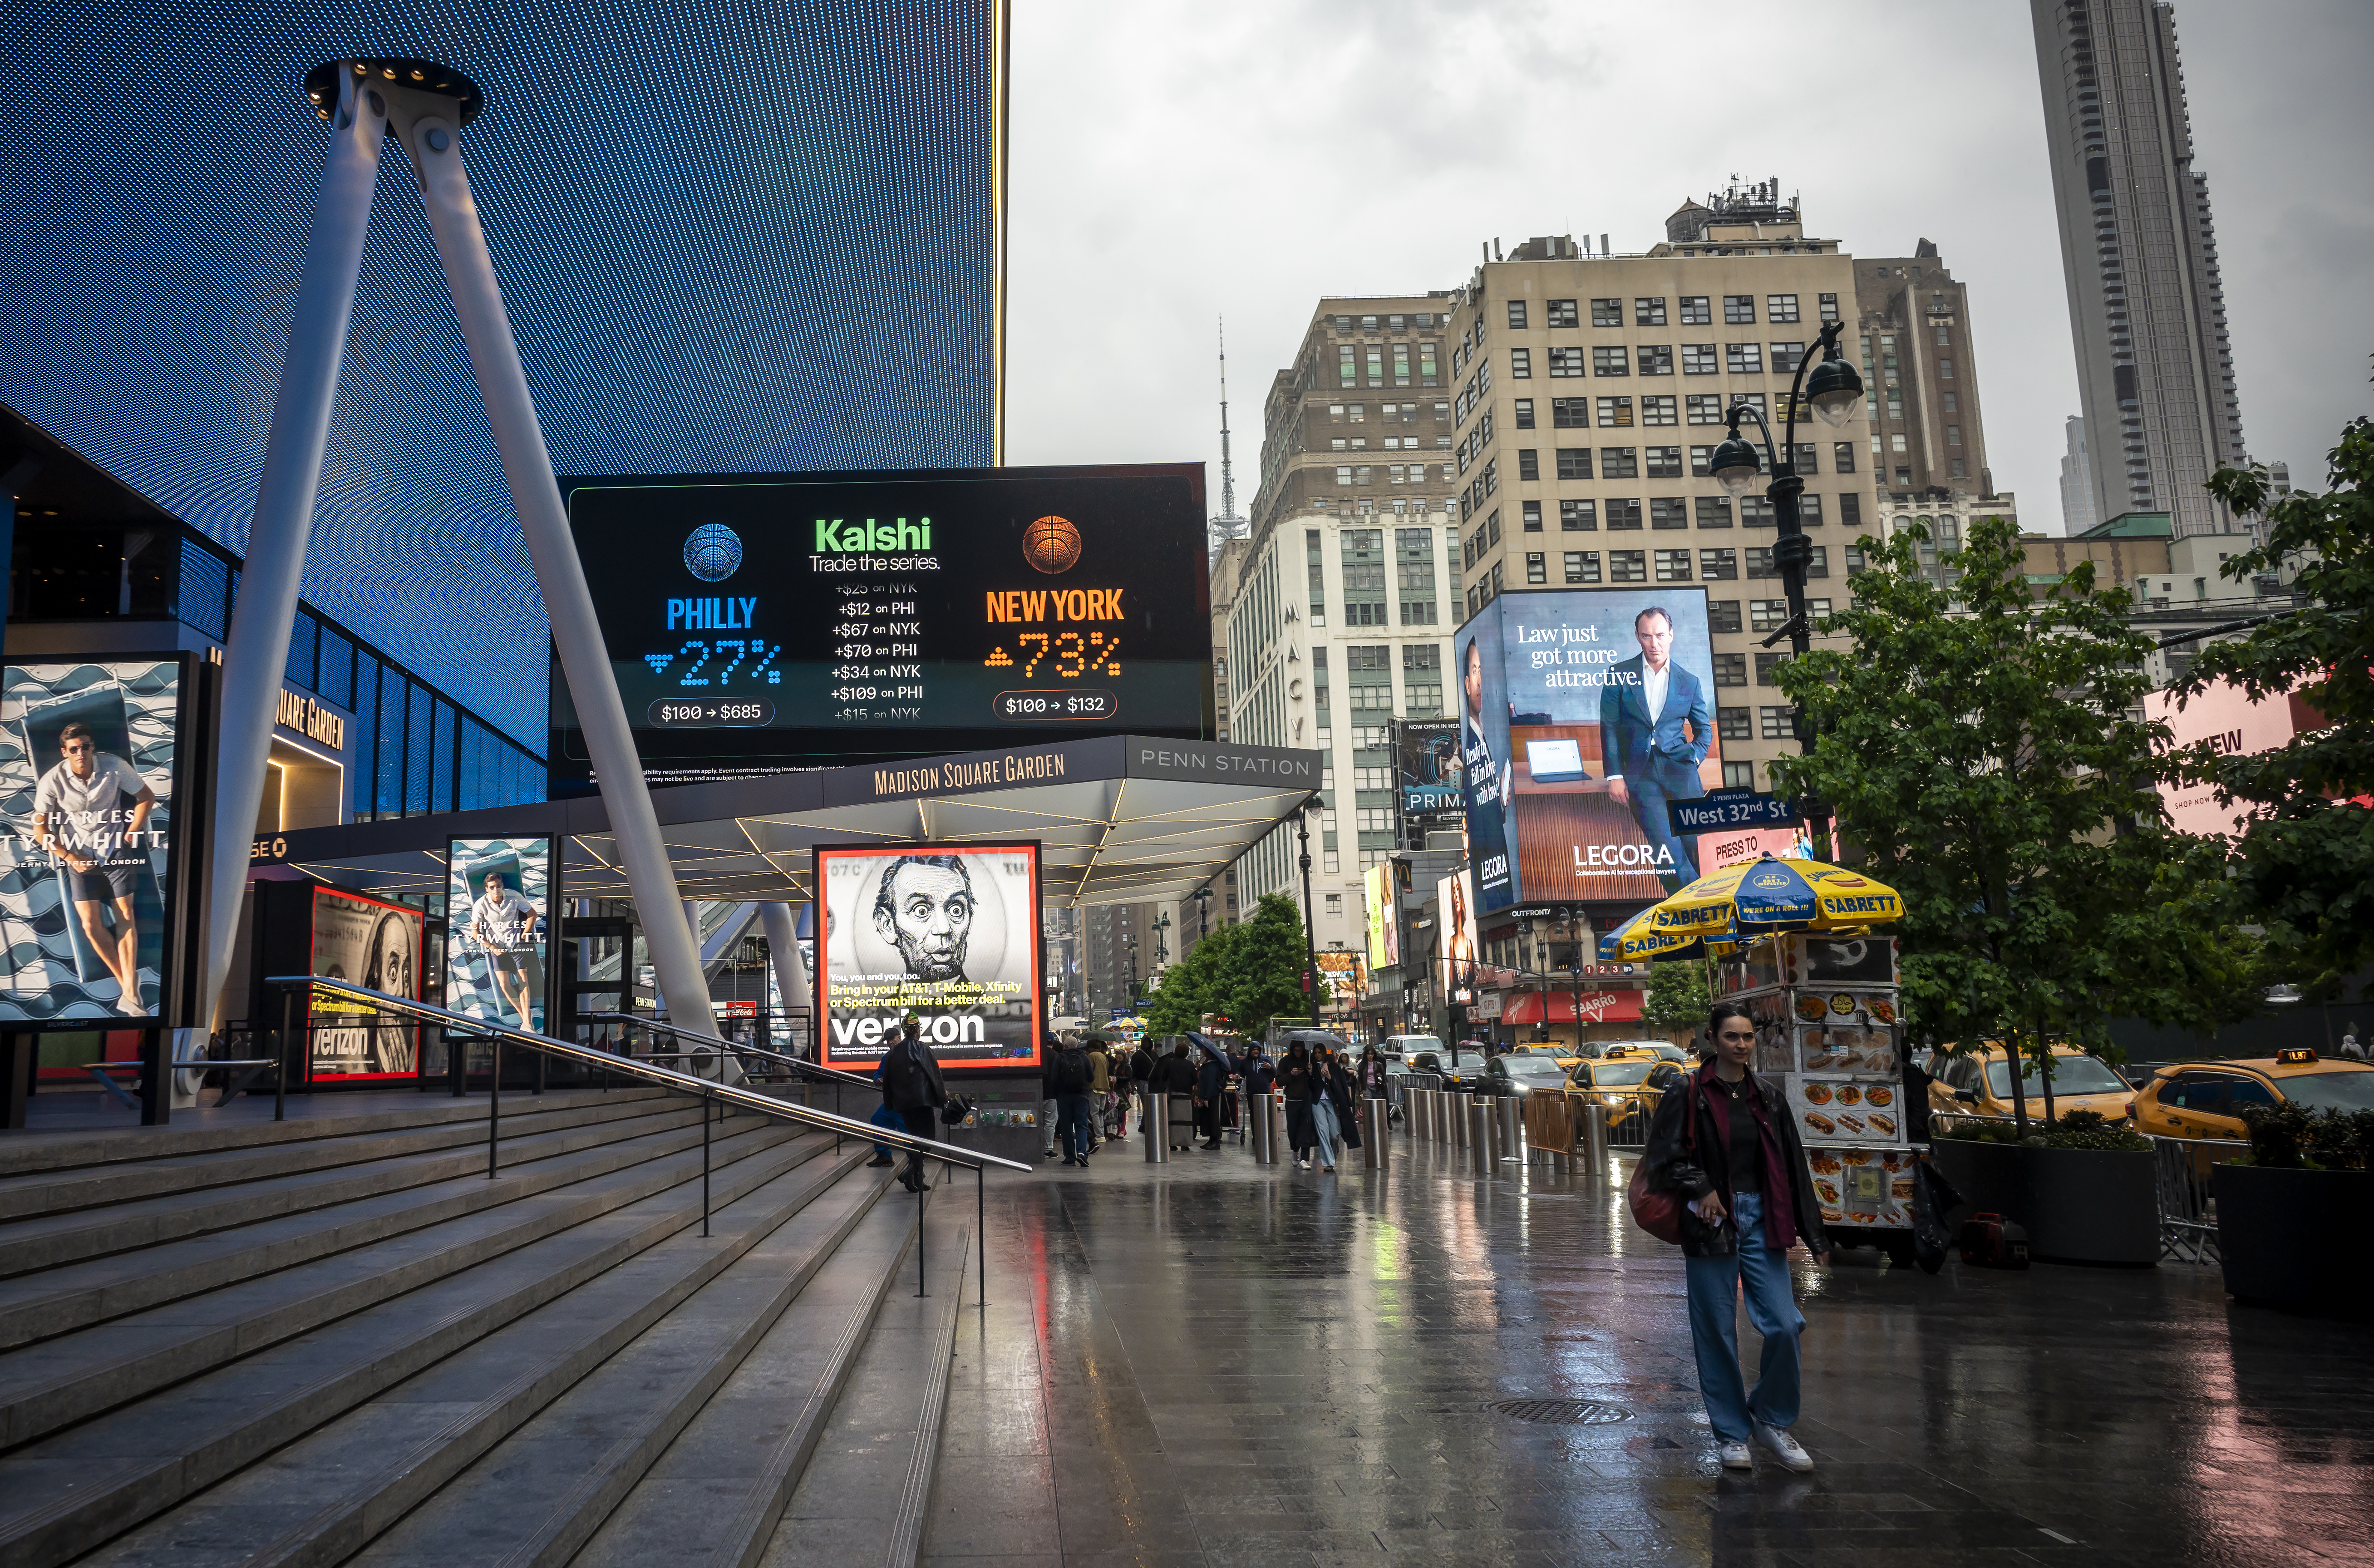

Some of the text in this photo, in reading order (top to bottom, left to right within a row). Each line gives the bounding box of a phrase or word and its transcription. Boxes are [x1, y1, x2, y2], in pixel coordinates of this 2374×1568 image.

[816, 517, 931, 552] Kalshi
[809, 554, 940, 572] Trade the series.
[836, 583, 868, 596] +$25
[890, 582, 917, 593] NYK
[668, 597, 756, 630] PHILLY
[839, 602, 870, 617] +$12
[892, 602, 914, 614] PHI
[986, 589, 1124, 622] NEW YORK
[833, 623, 869, 638] +$67
[890, 622, 920, 635] NYK
[1517, 624, 1599, 646] Law just
[835, 644, 871, 659] +$70
[893, 644, 917, 656] PHI
[1019, 632, 1121, 678] 73%
[1531, 648, 1618, 669] got more
[681, 640, 780, 685] 27%
[832, 665, 869, 680] +$34
[890, 665, 920, 677] NYK
[1546, 667, 1642, 687] attractive.
[831, 686, 876, 702] +$109
[898, 686, 922, 699] PHI
[662, 704, 761, 722] $100 $685
[835, 708, 867, 720] +$15
[891, 708, 921, 720] NYK
[1006, 696, 1104, 714] $100 $132
[308, 698, 344, 751] GARDEN
[1466, 741, 1487, 765] Ready to
[1142, 750, 1309, 775] PENN STATION
[875, 753, 1065, 795] MADISON SQUARE GARDEN
[1471, 760, 1496, 786] fall in love
[1476, 777, 1499, 806] with law?
[2175, 797, 2210, 809] SHOP NOW
[31, 809, 134, 825] CHARLES
[1679, 801, 1787, 825] West 32nd St
[0, 830, 165, 851] TYRWHITT
[1716, 836, 1757, 860] PRESS TO
[1574, 844, 1675, 866] LEGORA
[1481, 854, 1508, 881] LEGORA
[1805, 870, 1845, 882] SABRETT
[1823, 896, 1896, 913] SABRETT
[1657, 903, 1730, 926] SABRETT
[470, 921, 526, 929] CHARLES
[452, 932, 544, 944] TYRWHITT
[830, 974, 848, 983] You,
[850, 974, 866, 983] you
[867, 973, 881, 981] and
[884, 974, 902, 982] you,
[830, 981, 1022, 997] Bring in your AT&T, T-Mobile, Xfinity
[636, 997, 644, 1007] PENN
[830, 999, 842, 1008] or
[843, 997, 899, 1009] Spectrum
[900, 995, 917, 1006] bill
[918, 995, 934, 1006] for
[944, 995, 979, 1005] better
[979, 994, 1006, 1004] deal.
[2288, 1051, 2306, 1060] 1L87
